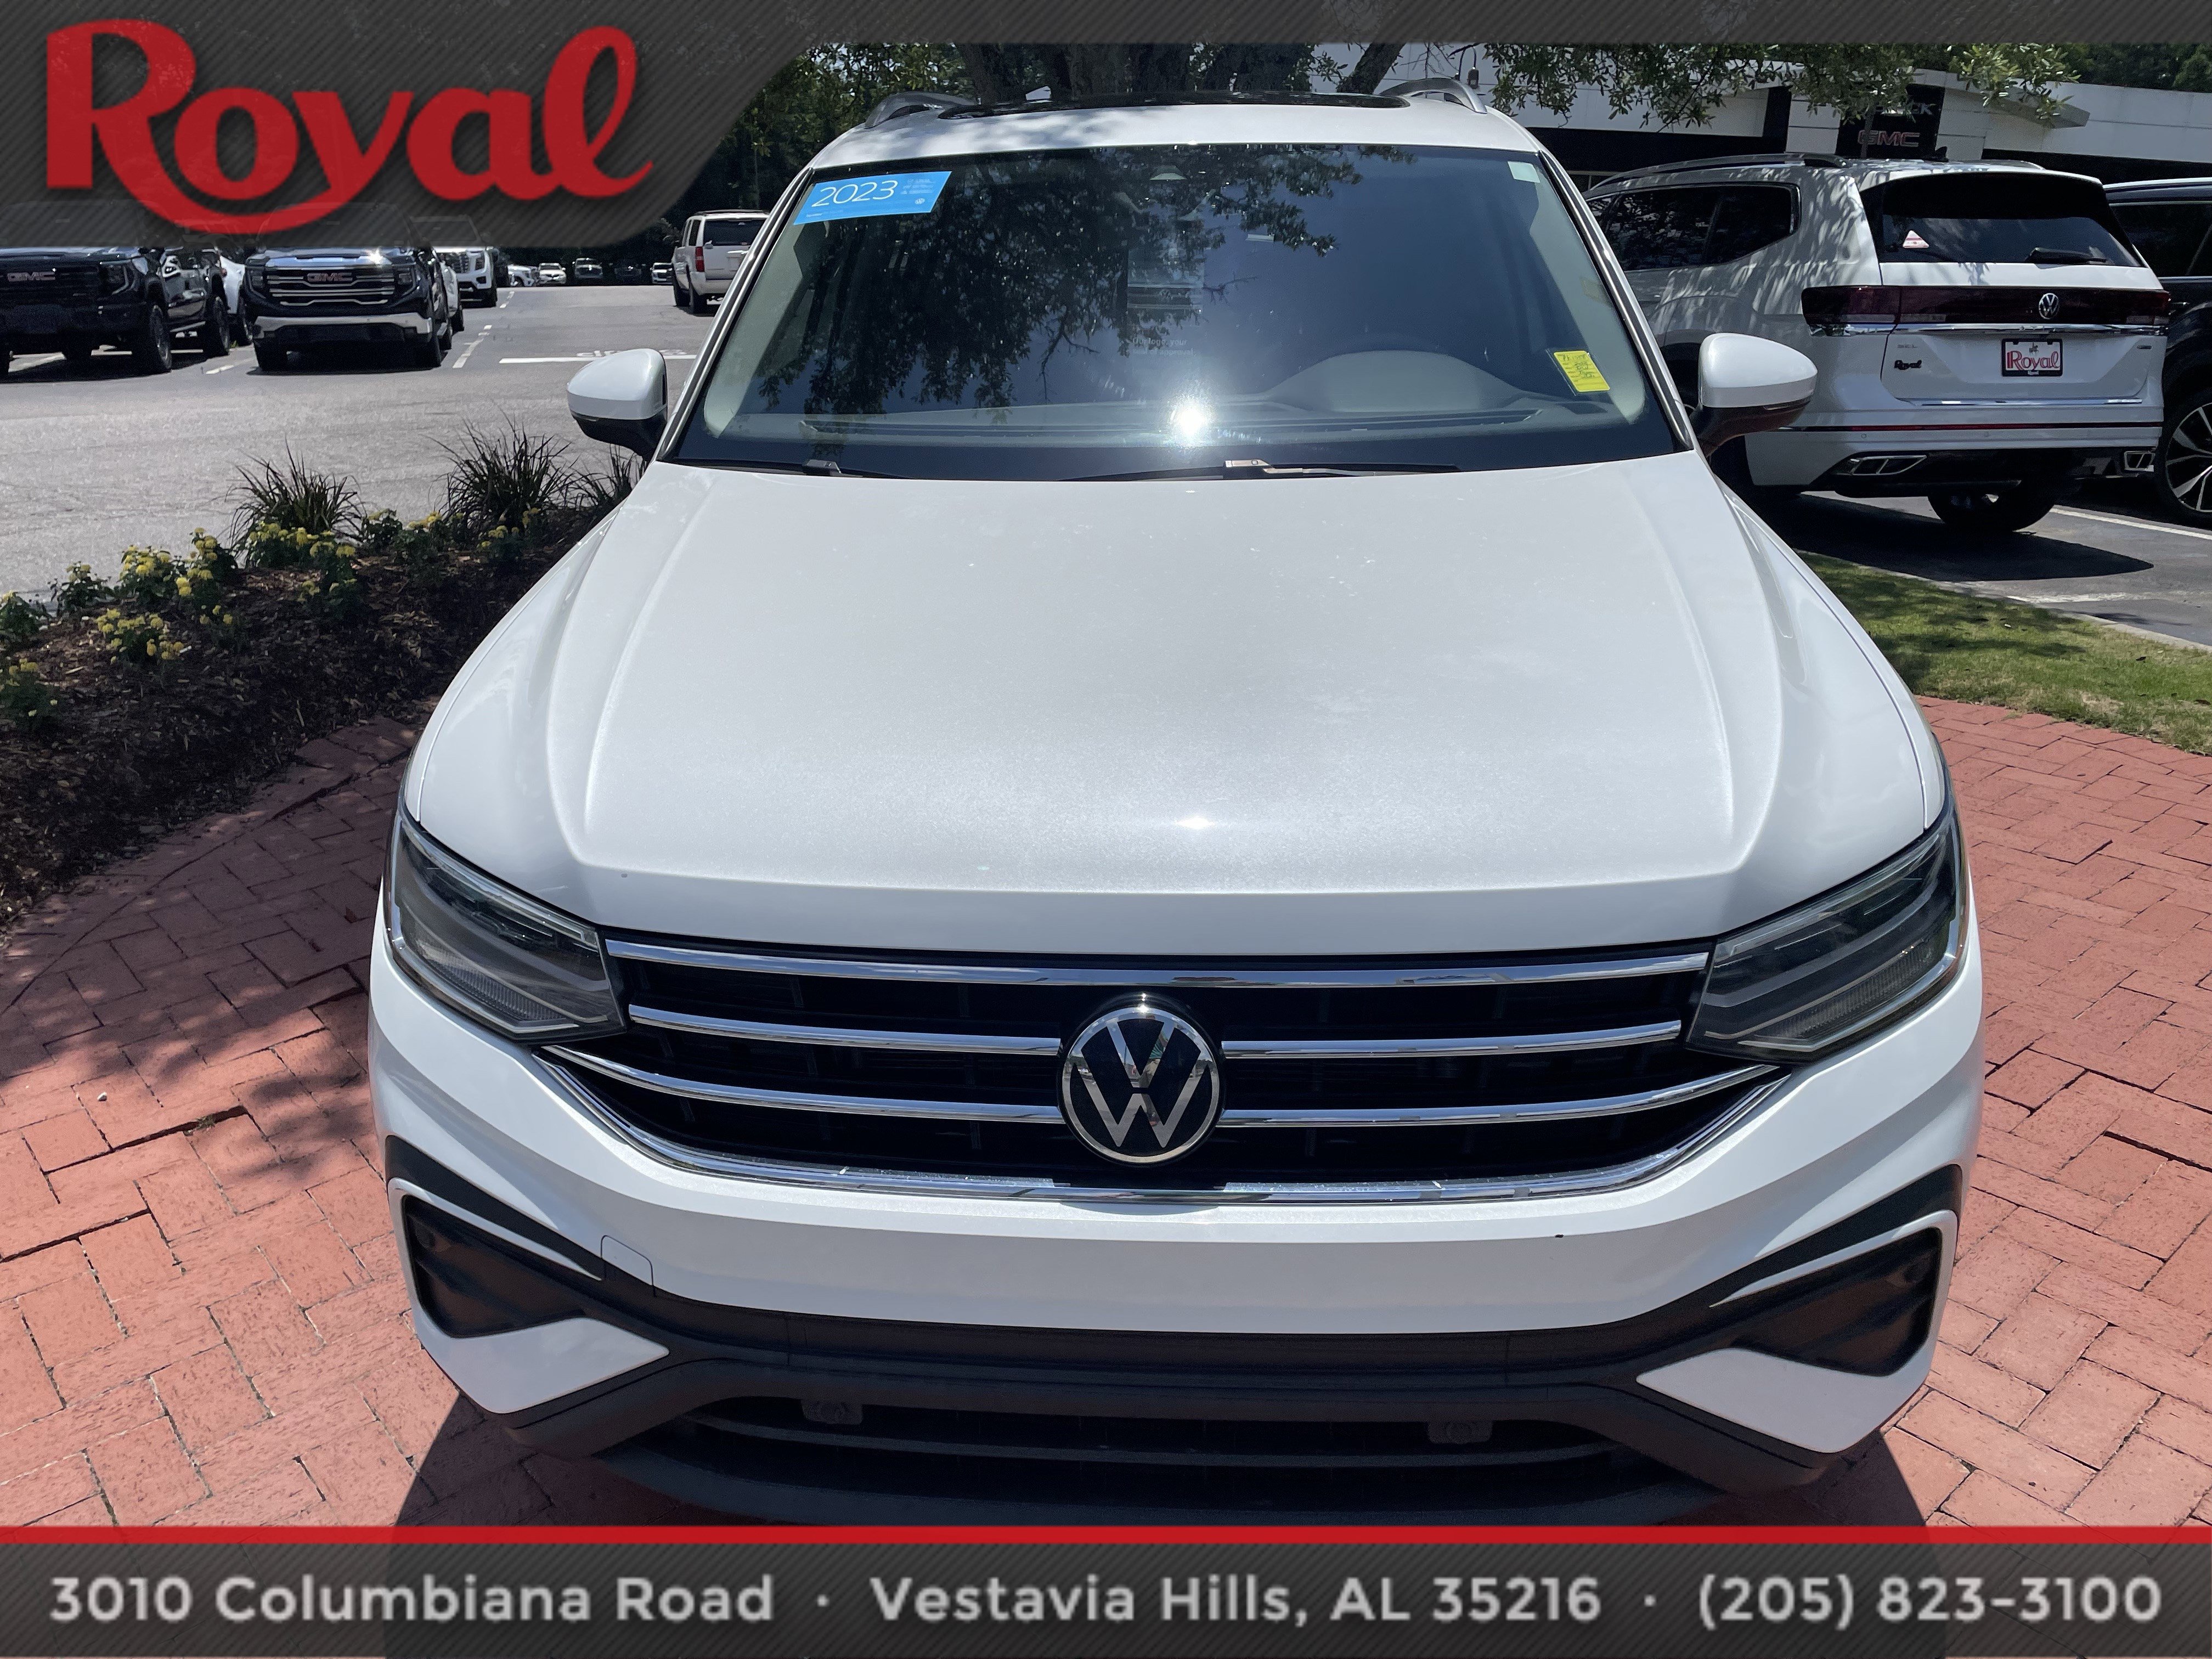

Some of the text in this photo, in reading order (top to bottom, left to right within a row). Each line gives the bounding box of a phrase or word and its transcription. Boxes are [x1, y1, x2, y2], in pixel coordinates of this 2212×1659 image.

[1858, 129, 1920, 147] GMC
[811, 180, 899, 208] 2023
[307, 272, 353, 282] GMC
[1170, 339, 1188, 347] your
[1894, 359, 1922, 370] Royal
[2006, 351, 2061, 372] Royal
